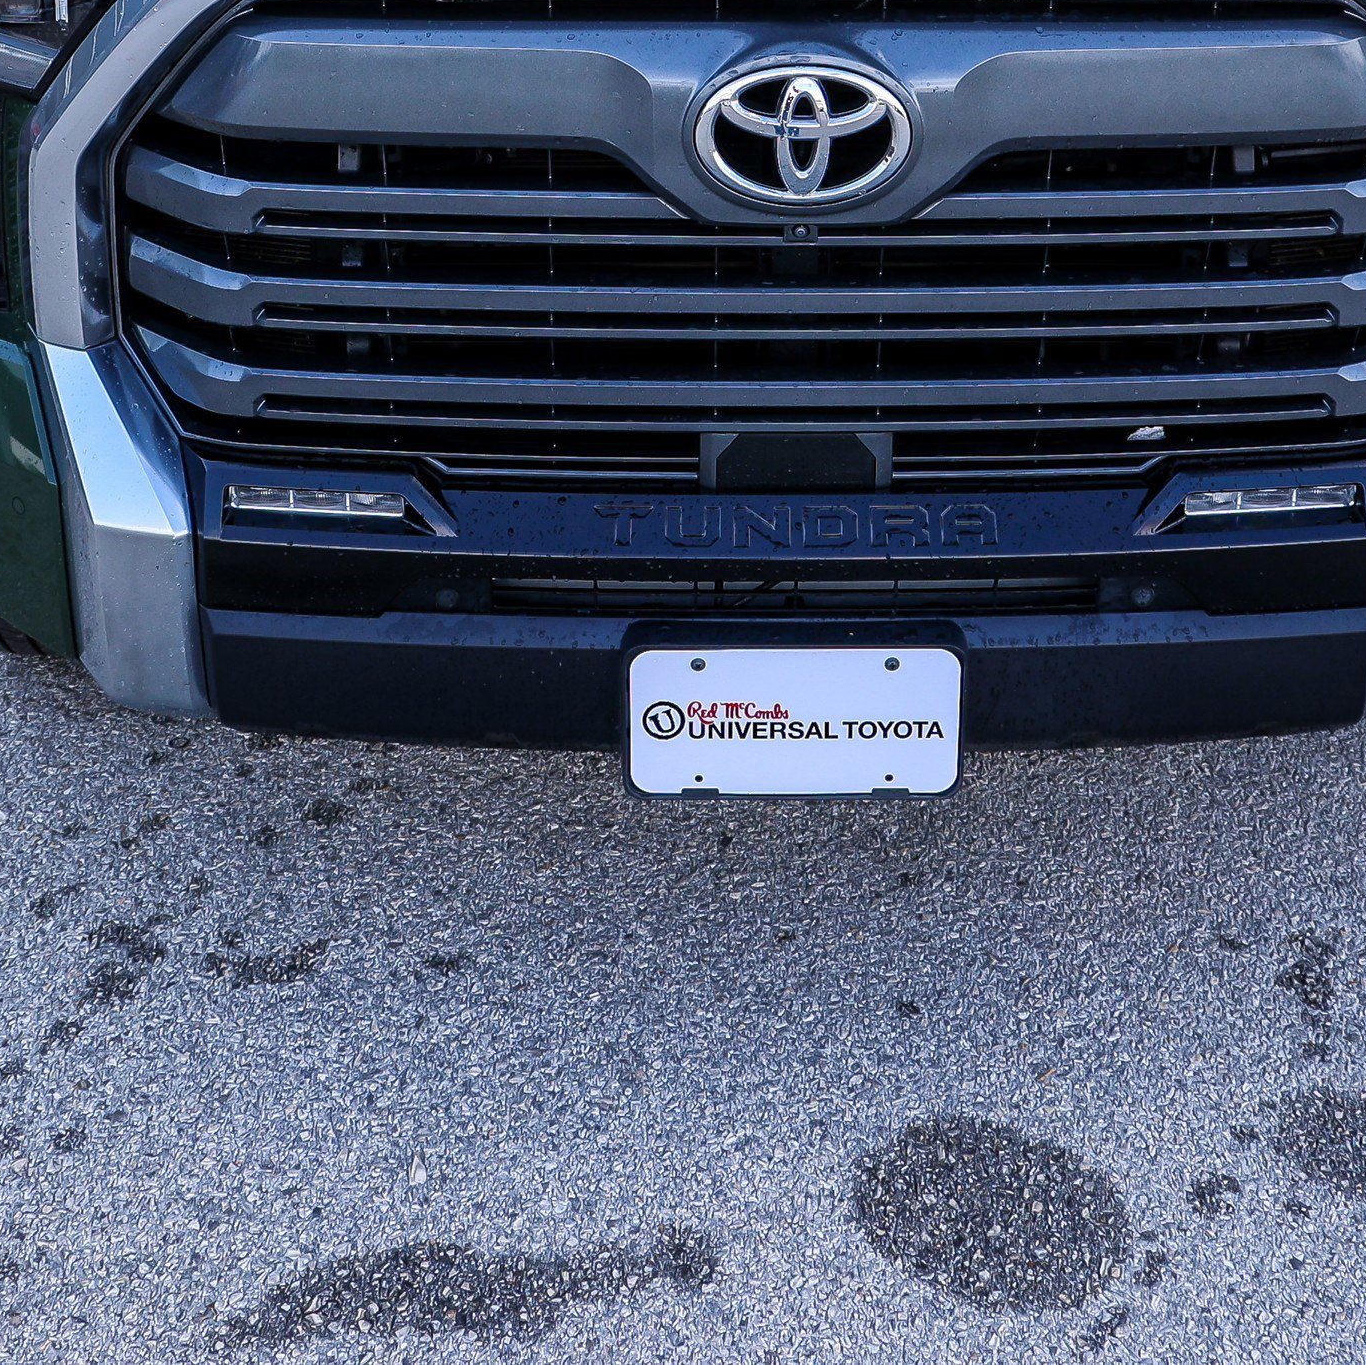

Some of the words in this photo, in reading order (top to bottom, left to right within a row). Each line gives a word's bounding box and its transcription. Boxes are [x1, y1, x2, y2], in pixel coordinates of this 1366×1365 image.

[593, 504, 999, 549] TUNDRA
[647, 707, 677, 735] U
[687, 701, 718, 725] Red
[720, 701, 789, 720] McCombs
[688, 721, 838, 740] UNIVERSAL
[842, 720, 944, 740] TOYOTA
